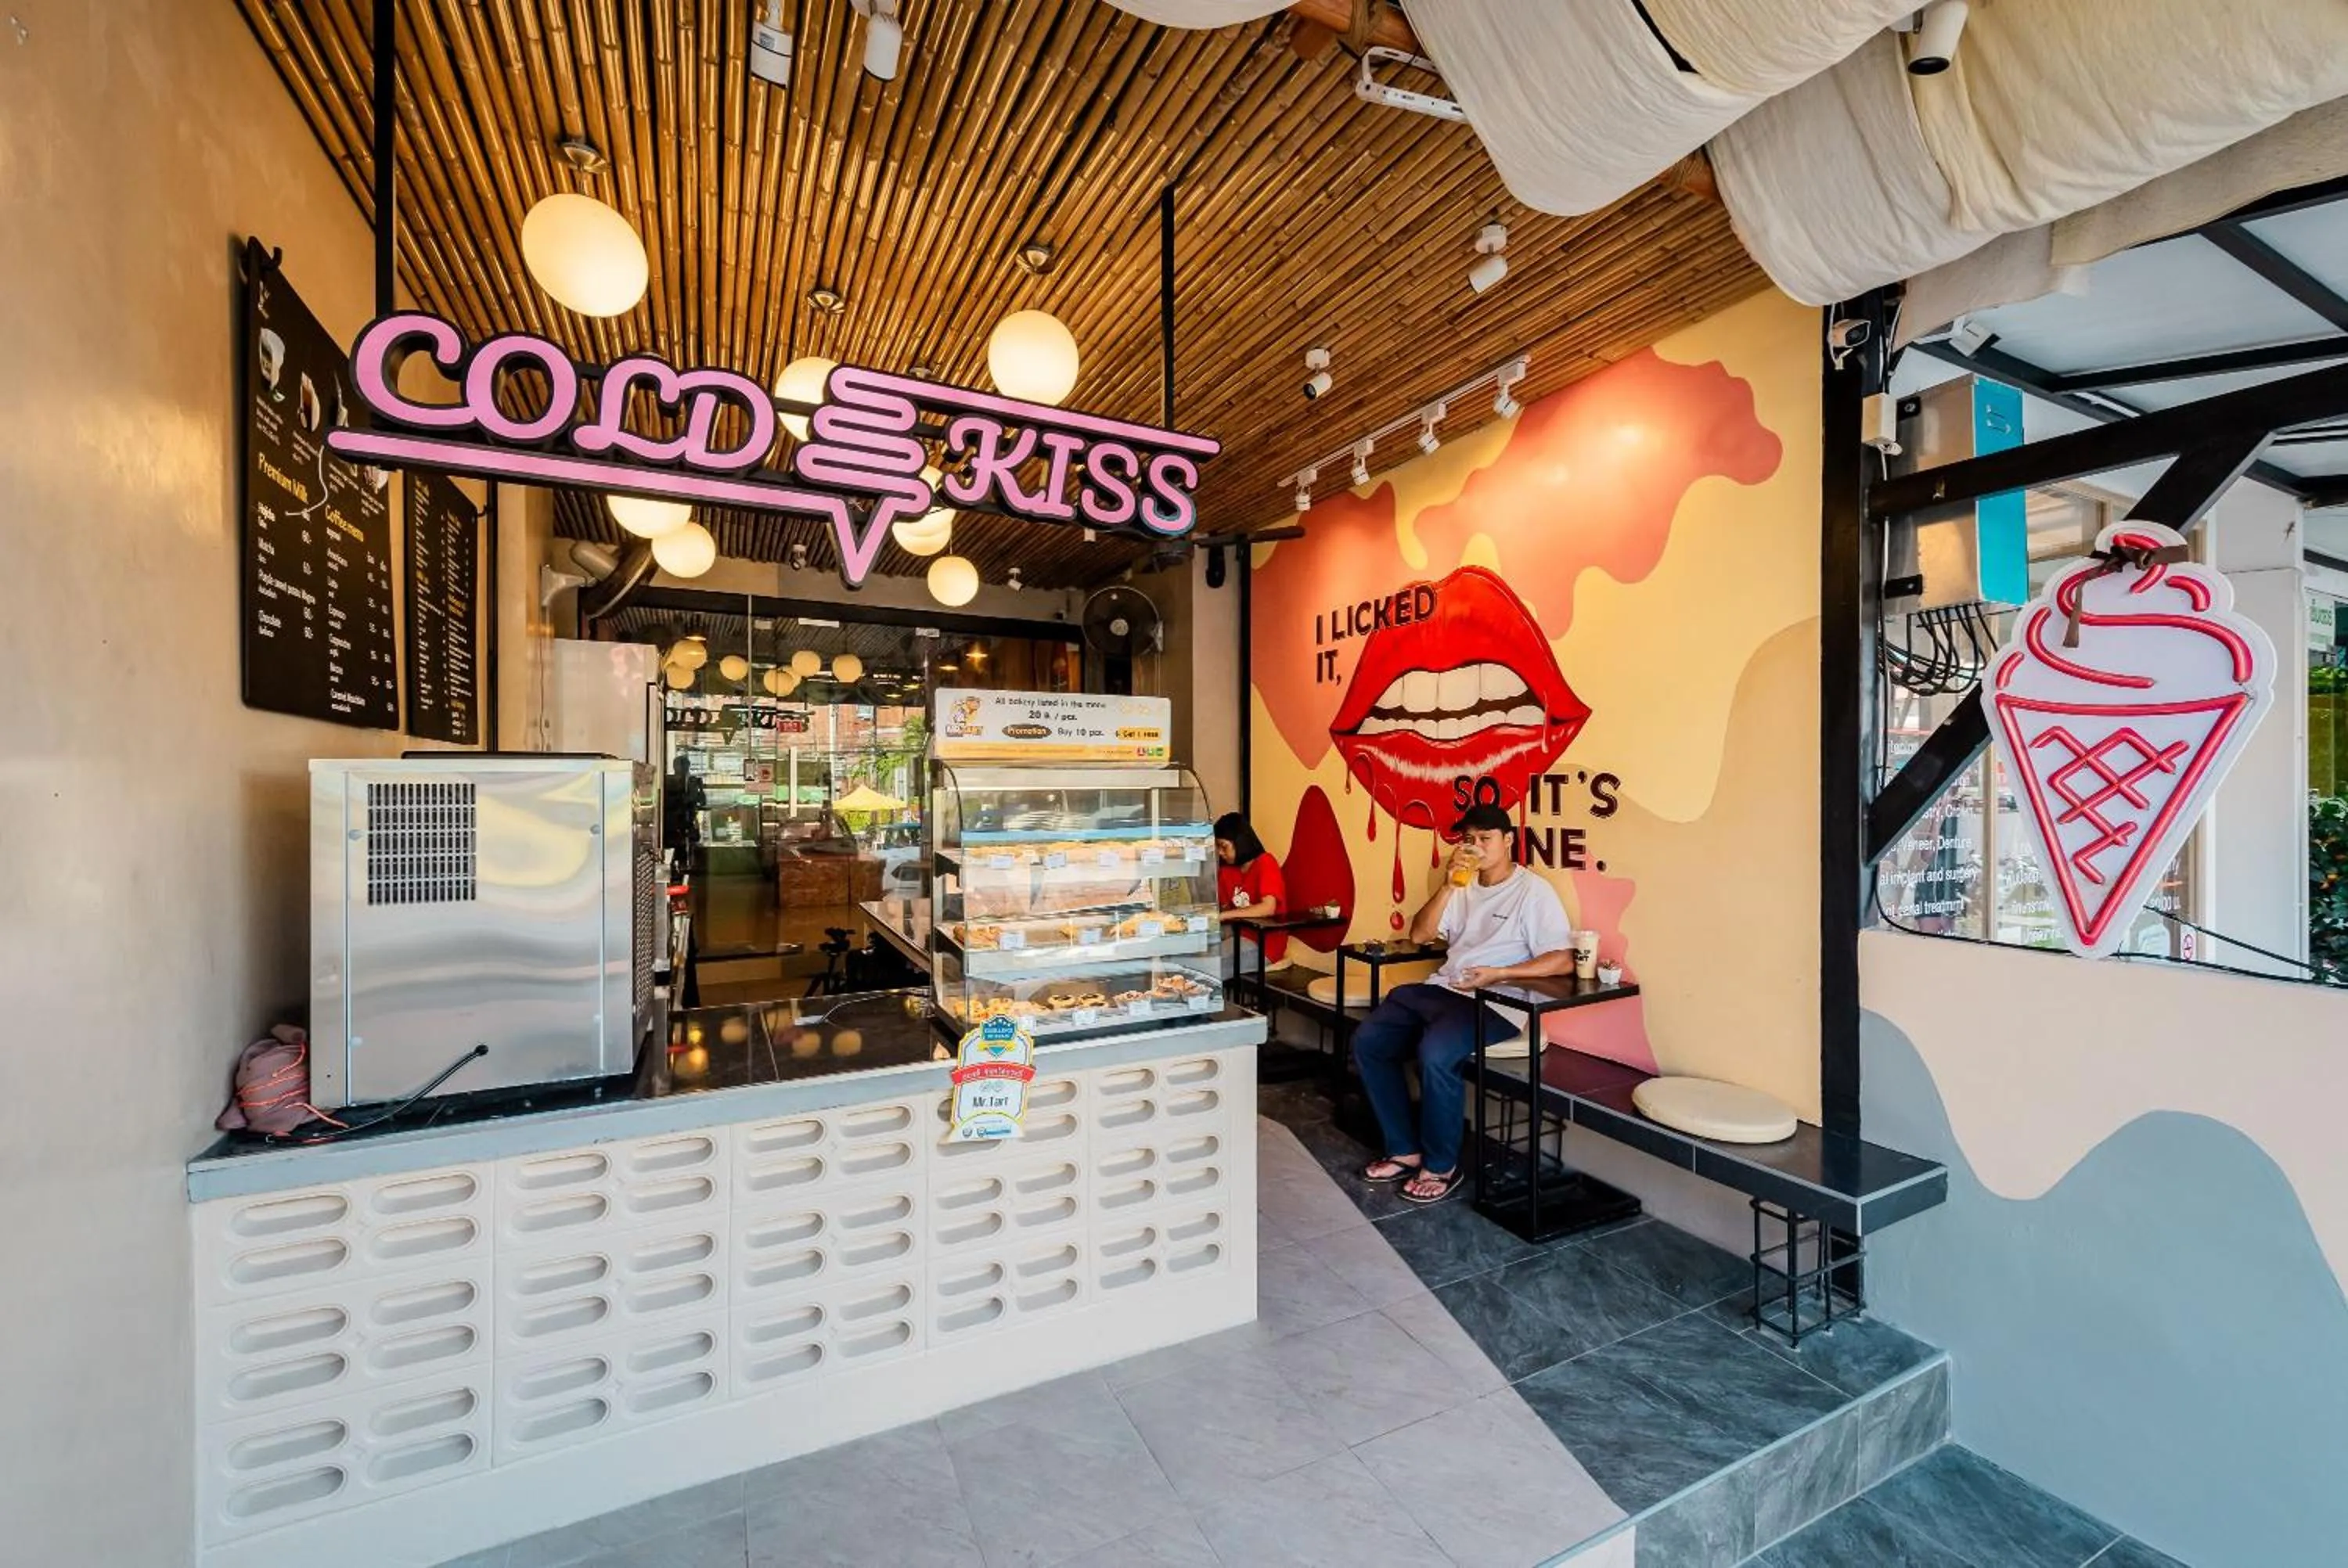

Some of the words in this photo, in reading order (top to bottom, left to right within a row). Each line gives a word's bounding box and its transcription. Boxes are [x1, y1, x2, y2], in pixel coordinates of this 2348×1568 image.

[351, 311, 778, 472] COLD
[941, 415, 1201, 534] KISS
[1316, 614, 1323, 645] I
[1331, 584, 1435, 642] LICKED
[1316, 649, 1341, 685] IT,
[1028, 710, 1041, 719] 20
[1057, 727, 1072, 736] Buy
[1453, 775, 1500, 812] SO
[1529, 771, 1621, 818] IT'S
[1511, 825, 1606, 872] INE.
[1927, 868, 1943, 882] and
